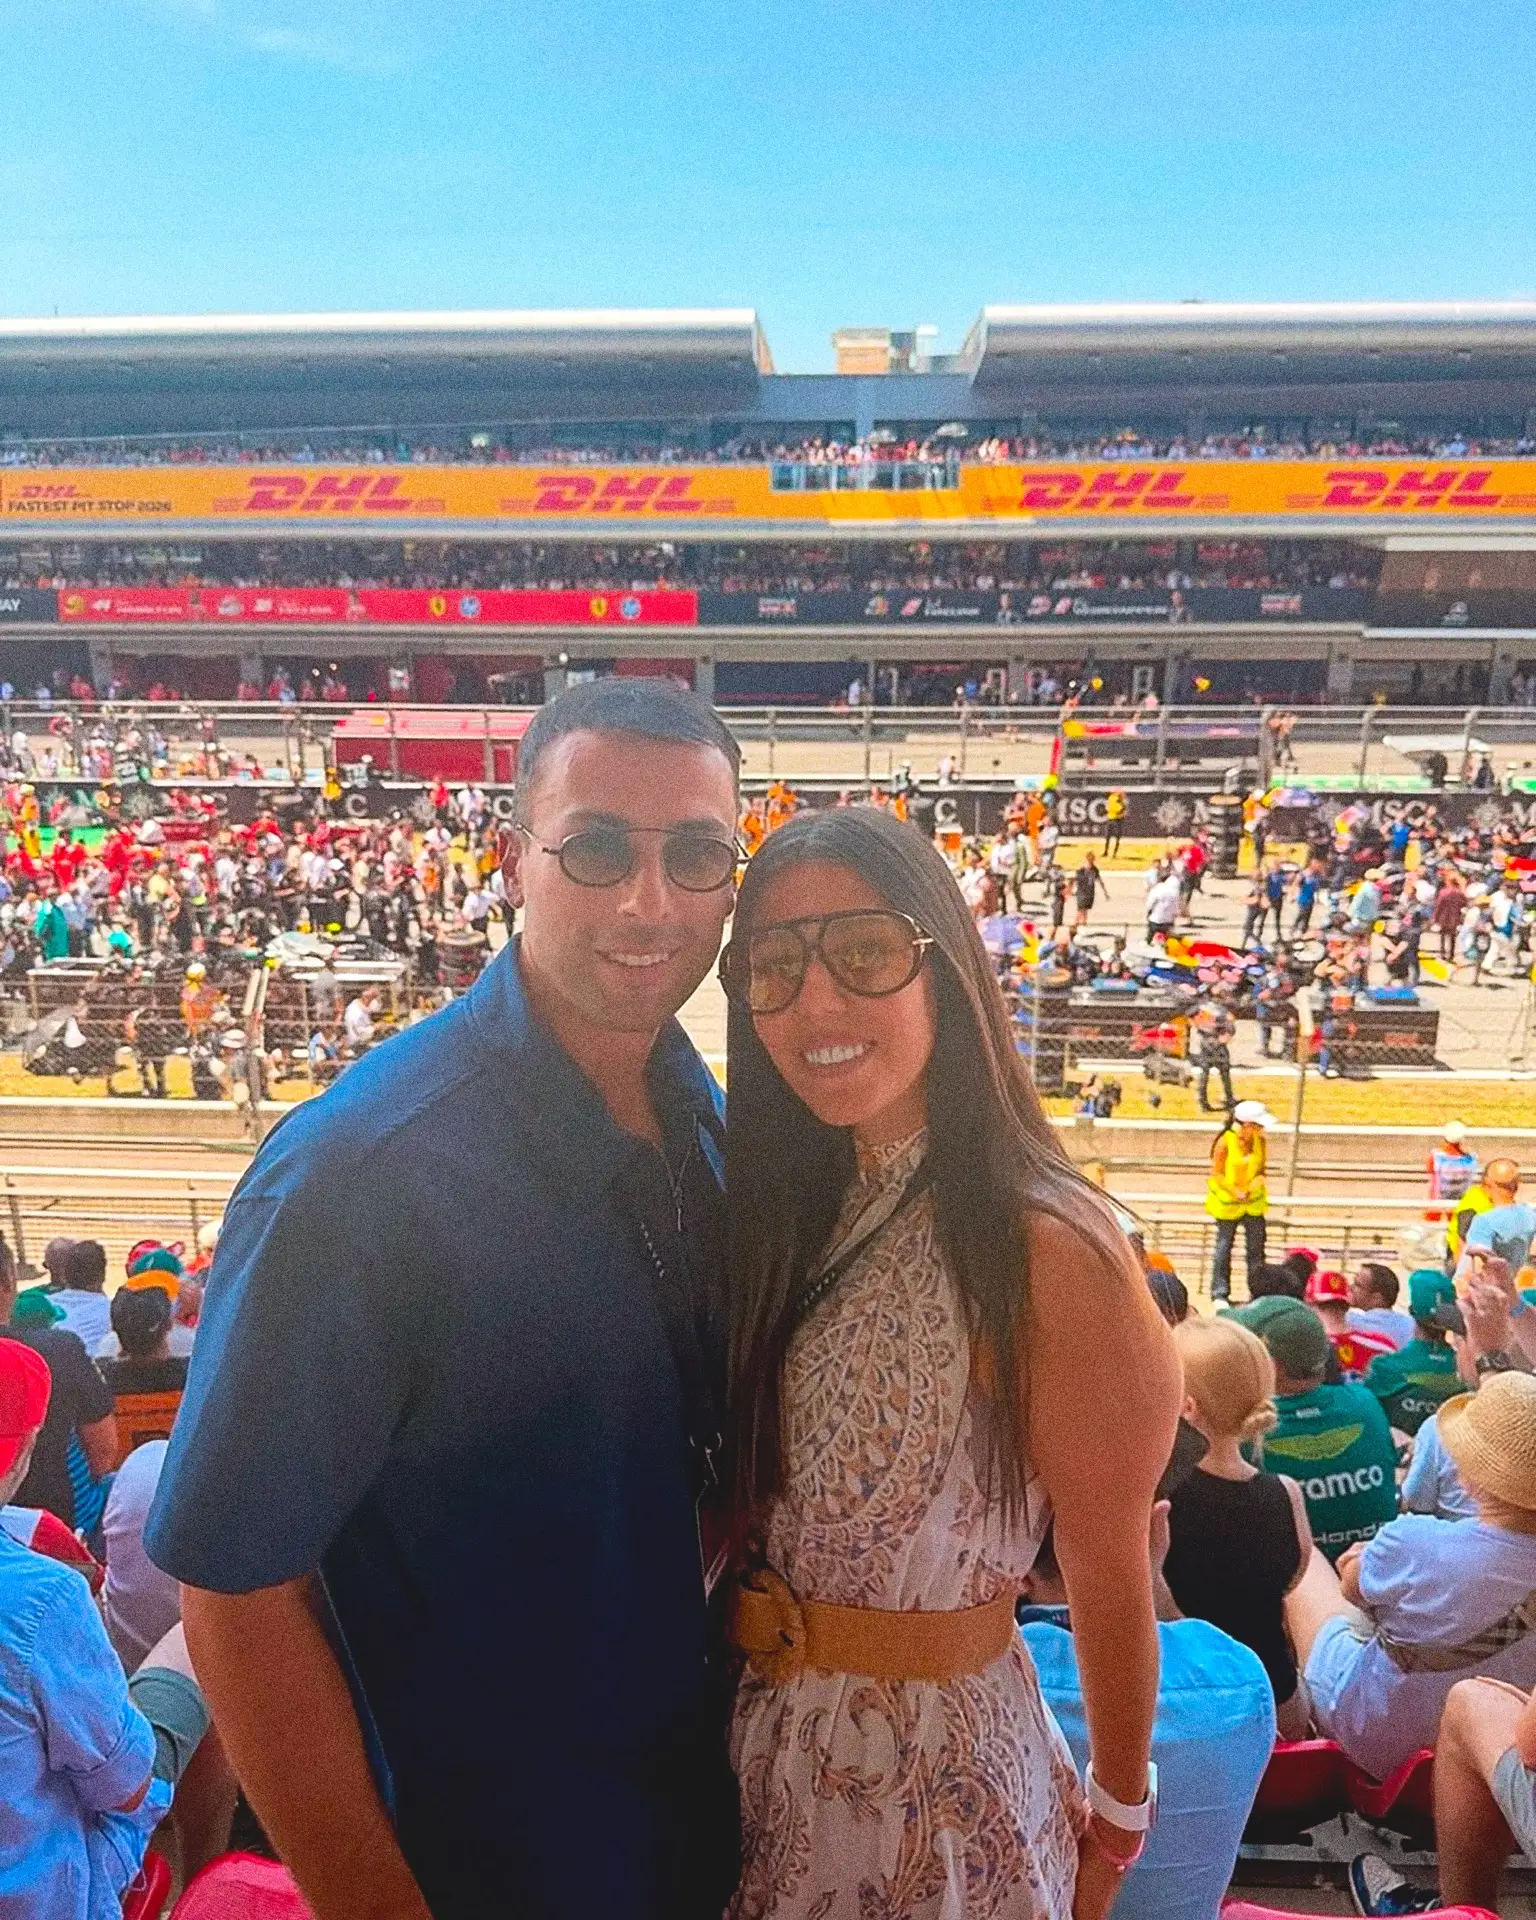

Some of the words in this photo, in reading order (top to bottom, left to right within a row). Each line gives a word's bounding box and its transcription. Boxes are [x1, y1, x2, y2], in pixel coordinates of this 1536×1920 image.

[9, 500, 67, 512] FASTEST
[72, 500, 94, 512] PIT
[99, 500, 135, 512] STOP
[245, 476, 412, 511] DHL
[534, 476, 701, 511] DHL
[1019, 473, 1195, 508] DHL
[1322, 471, 1501, 507] DHL
[1301, 1465, 1383, 1500] amco
